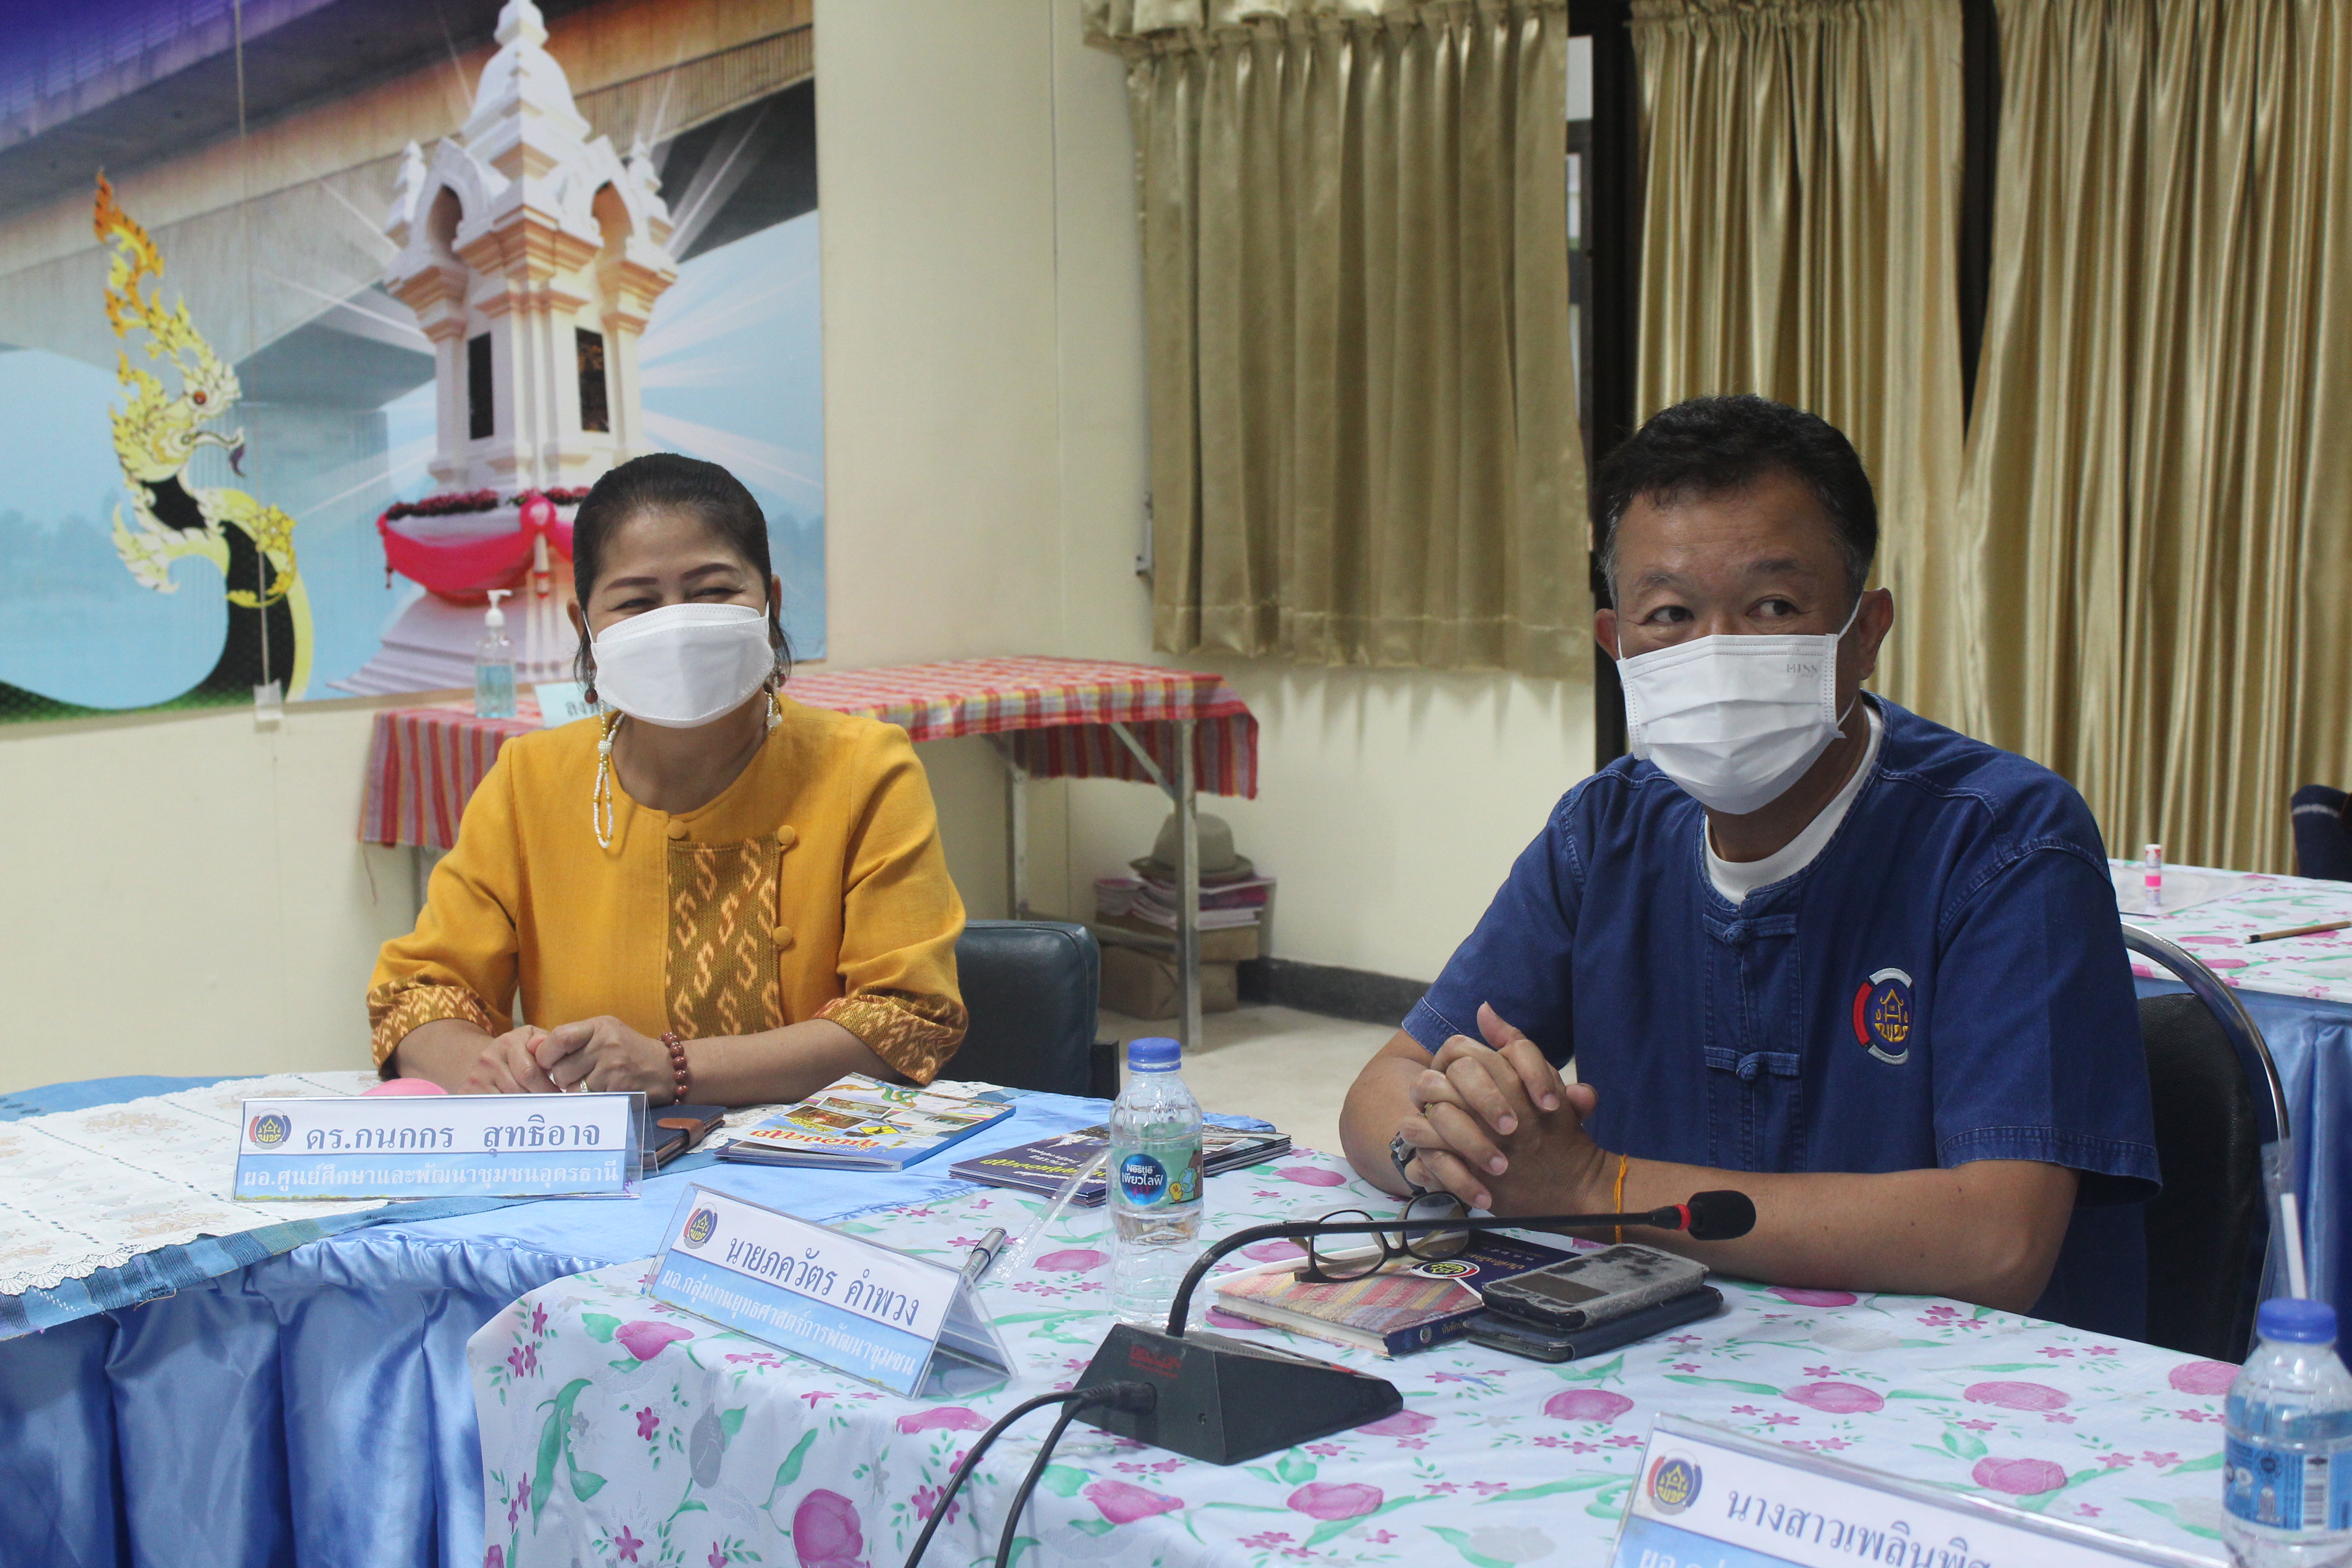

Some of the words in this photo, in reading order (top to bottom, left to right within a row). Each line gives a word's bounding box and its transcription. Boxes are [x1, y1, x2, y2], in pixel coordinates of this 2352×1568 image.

[306, 1125, 455, 1150] ดร.กนกกร
[482, 1114, 602, 1157] สุทธิอาจ
[243, 1159, 619, 1192] ผอ.ศูนย์ศึกษาและพัฒนาชุมชนอุดรธานี
[1127, 1164, 1153, 1174] Nestlé
[725, 1237, 838, 1296] นายภควัตร
[843, 1269, 920, 1326] คำพวง
[662, 1269, 916, 1376] ผอ.กลุ่มงานยุทธศาสตร์การพัฒนาชุมชน
